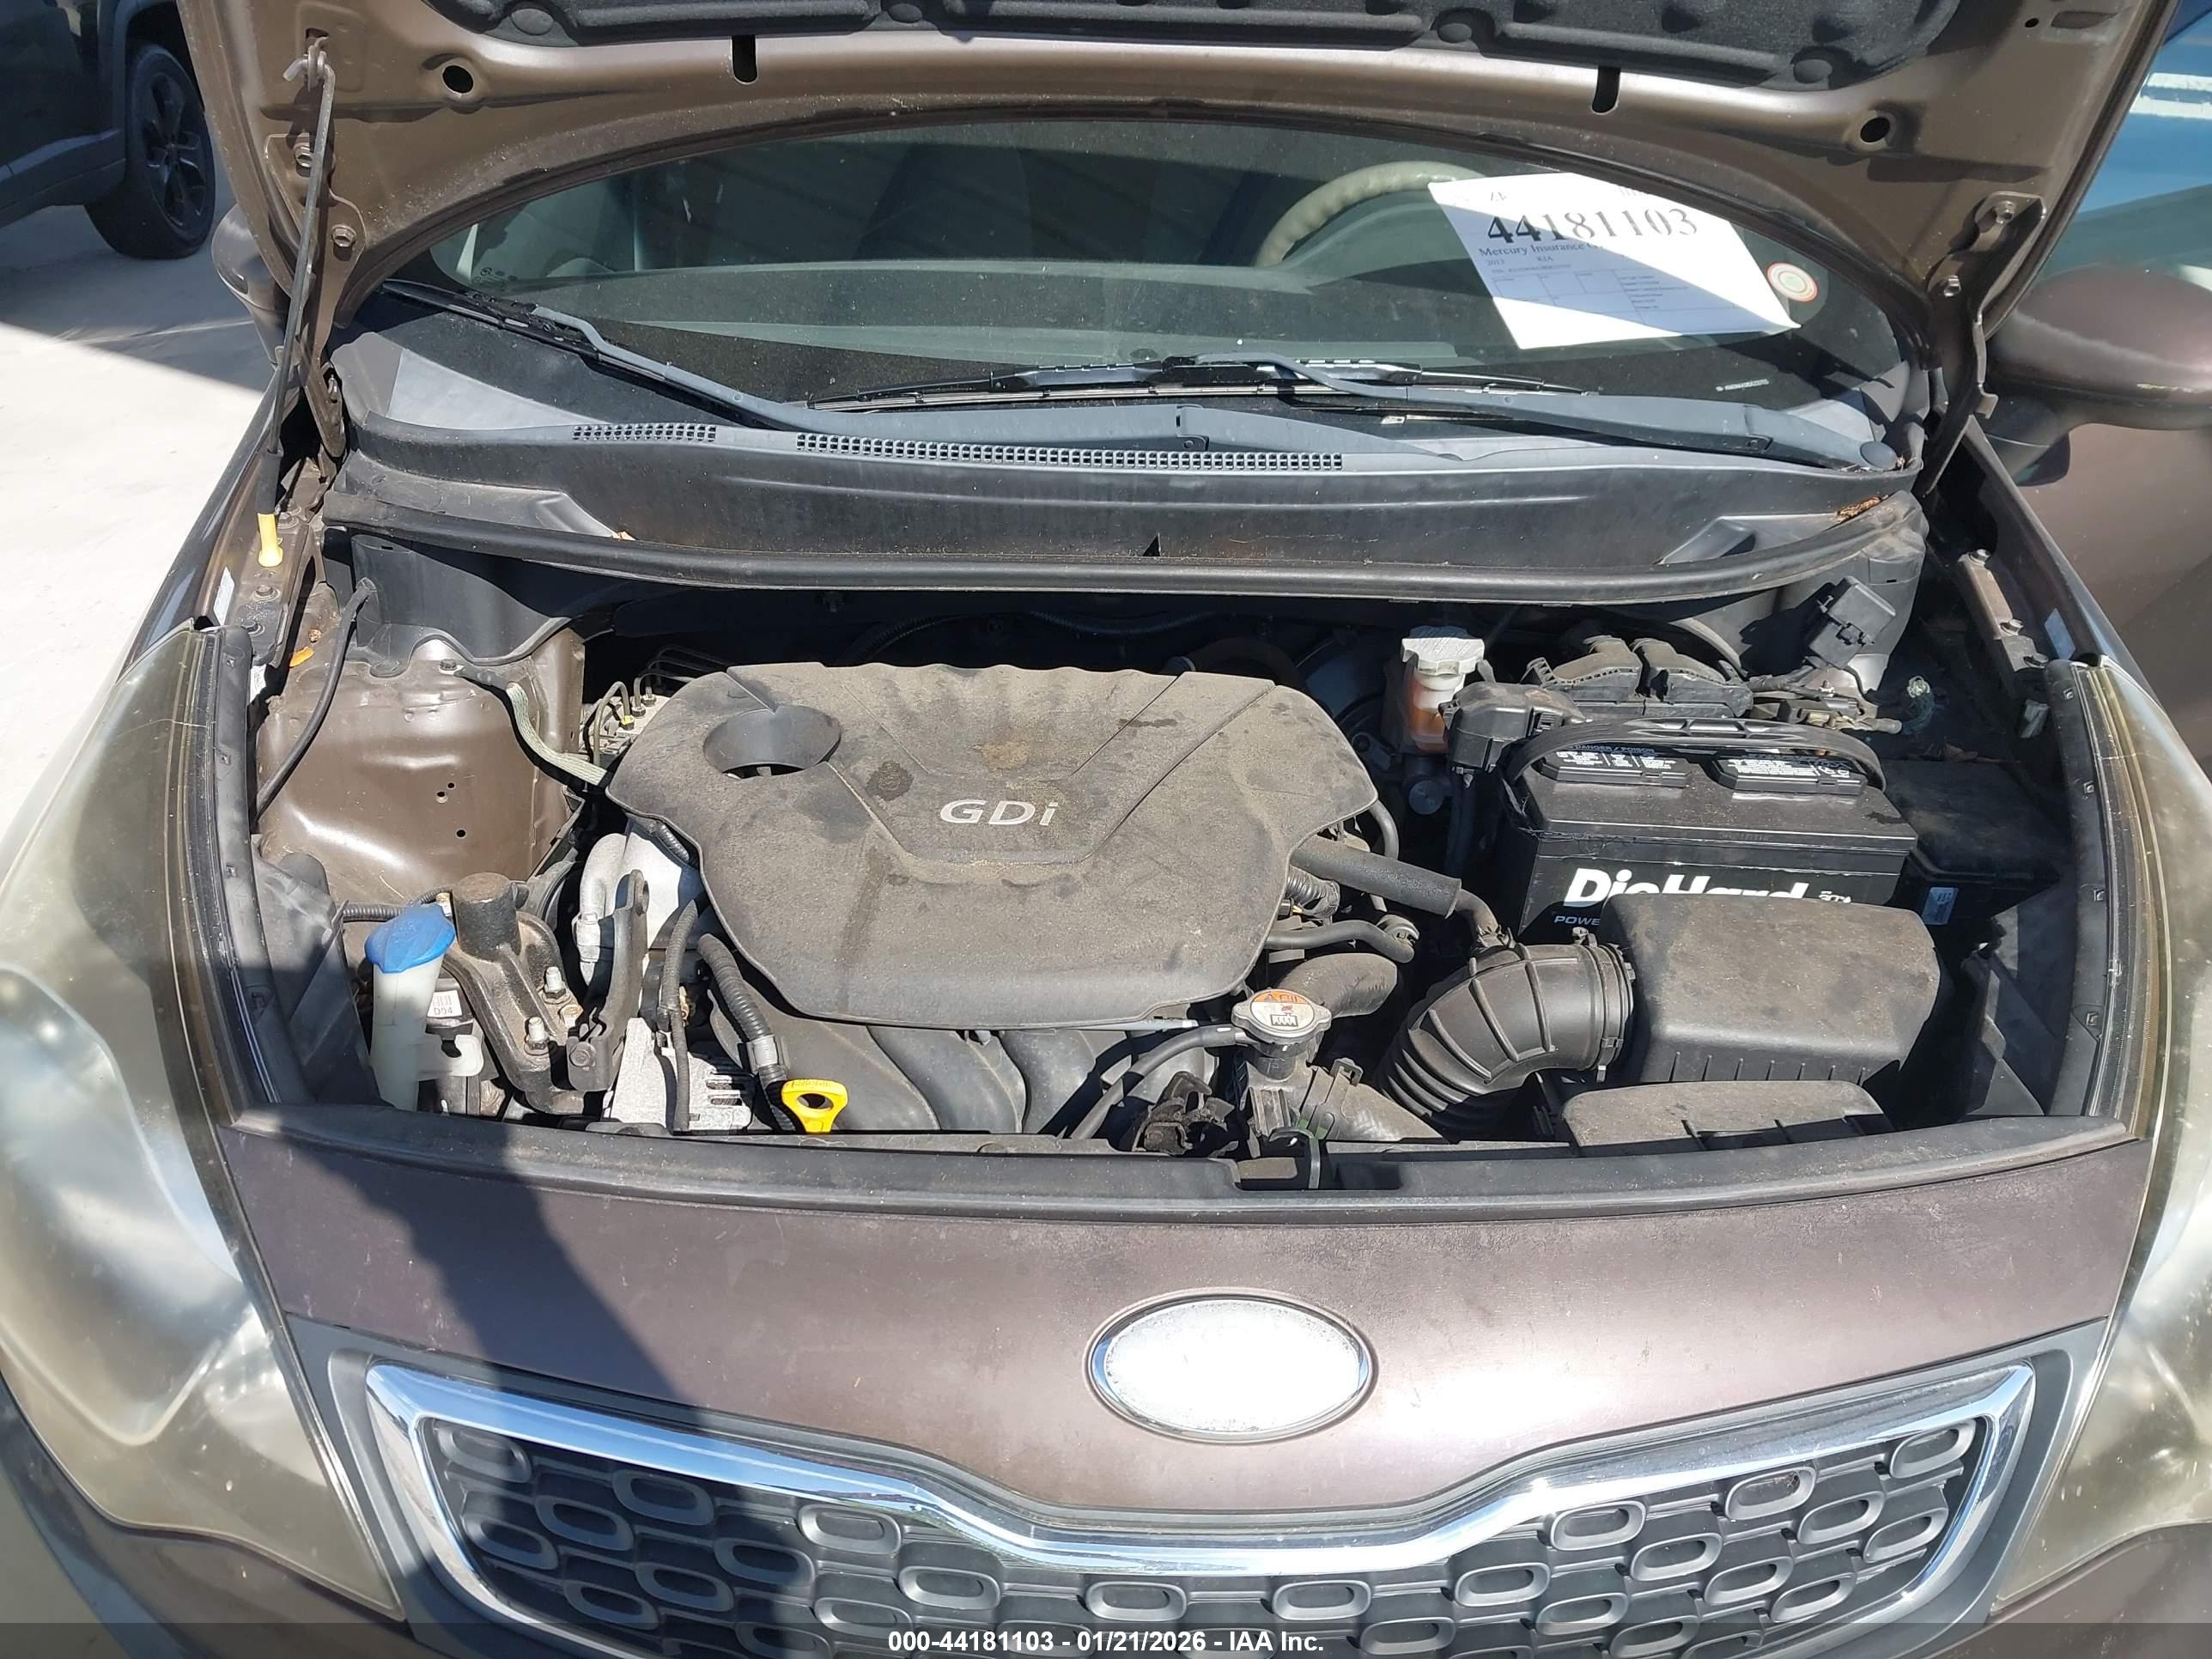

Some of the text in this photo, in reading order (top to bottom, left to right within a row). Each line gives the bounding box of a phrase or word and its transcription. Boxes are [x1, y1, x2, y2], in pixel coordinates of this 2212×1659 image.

[1487, 208, 1697, 244] 44181103
[1479, 246, 1528, 257] Mercury
[1530, 243, 1585, 253] Insurance
[940, 799, 1059, 826] GDi
